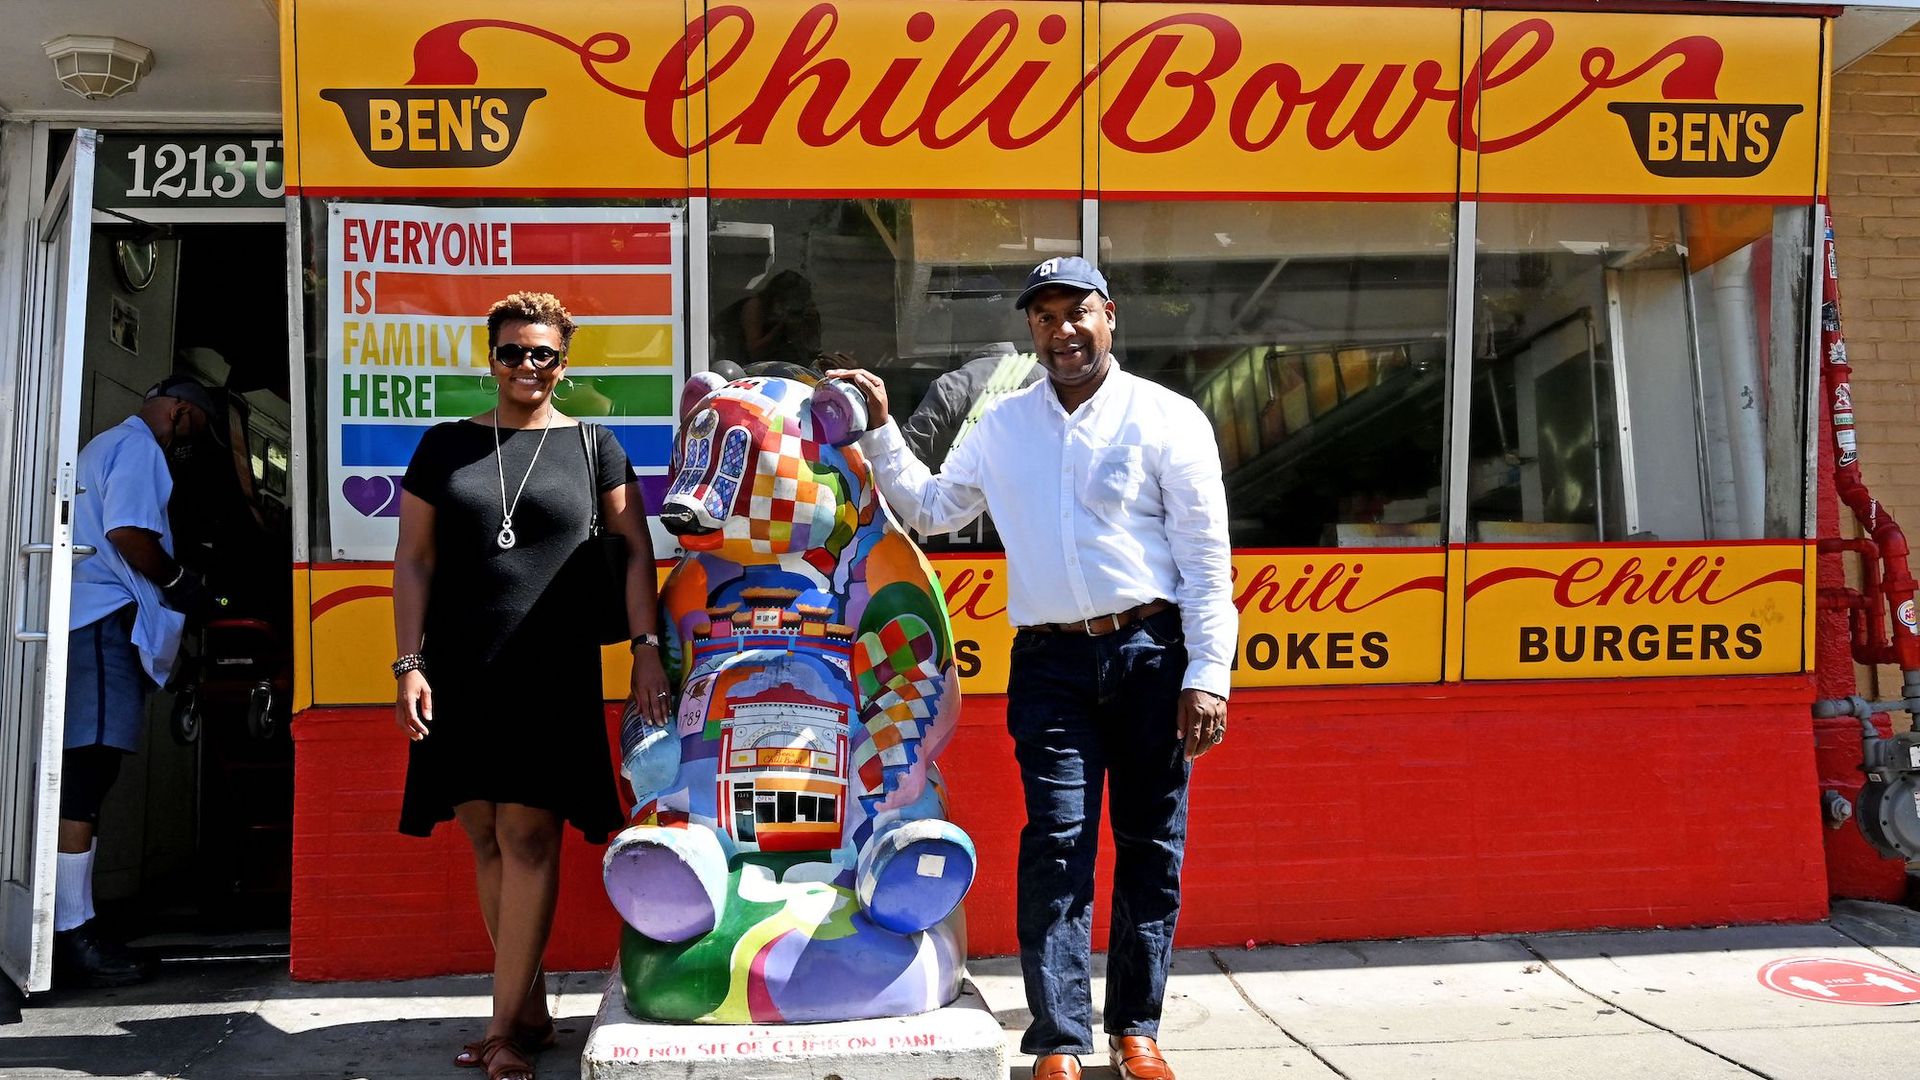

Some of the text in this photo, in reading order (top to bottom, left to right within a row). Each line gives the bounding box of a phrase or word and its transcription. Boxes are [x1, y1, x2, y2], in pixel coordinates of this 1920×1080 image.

[645, 3, 1556, 158] Chili Bowl
[369, 96, 511, 152] BEN'S
[1648, 110, 1770, 163] BEN'S
[343, 218, 508, 267] EVERYONE
[343, 271, 372, 316] IS
[343, 322, 467, 367] FAMILY
[343, 373, 433, 418] HERE
[1232, 562, 1364, 614] hili
[1553, 556, 1727, 608] Chili
[1231, 631, 1389, 671] OKES
[1518, 622, 1763, 664] BURGERS
[613, 1046, 639, 1058] DO
[847, 1037, 876, 1049] ON
